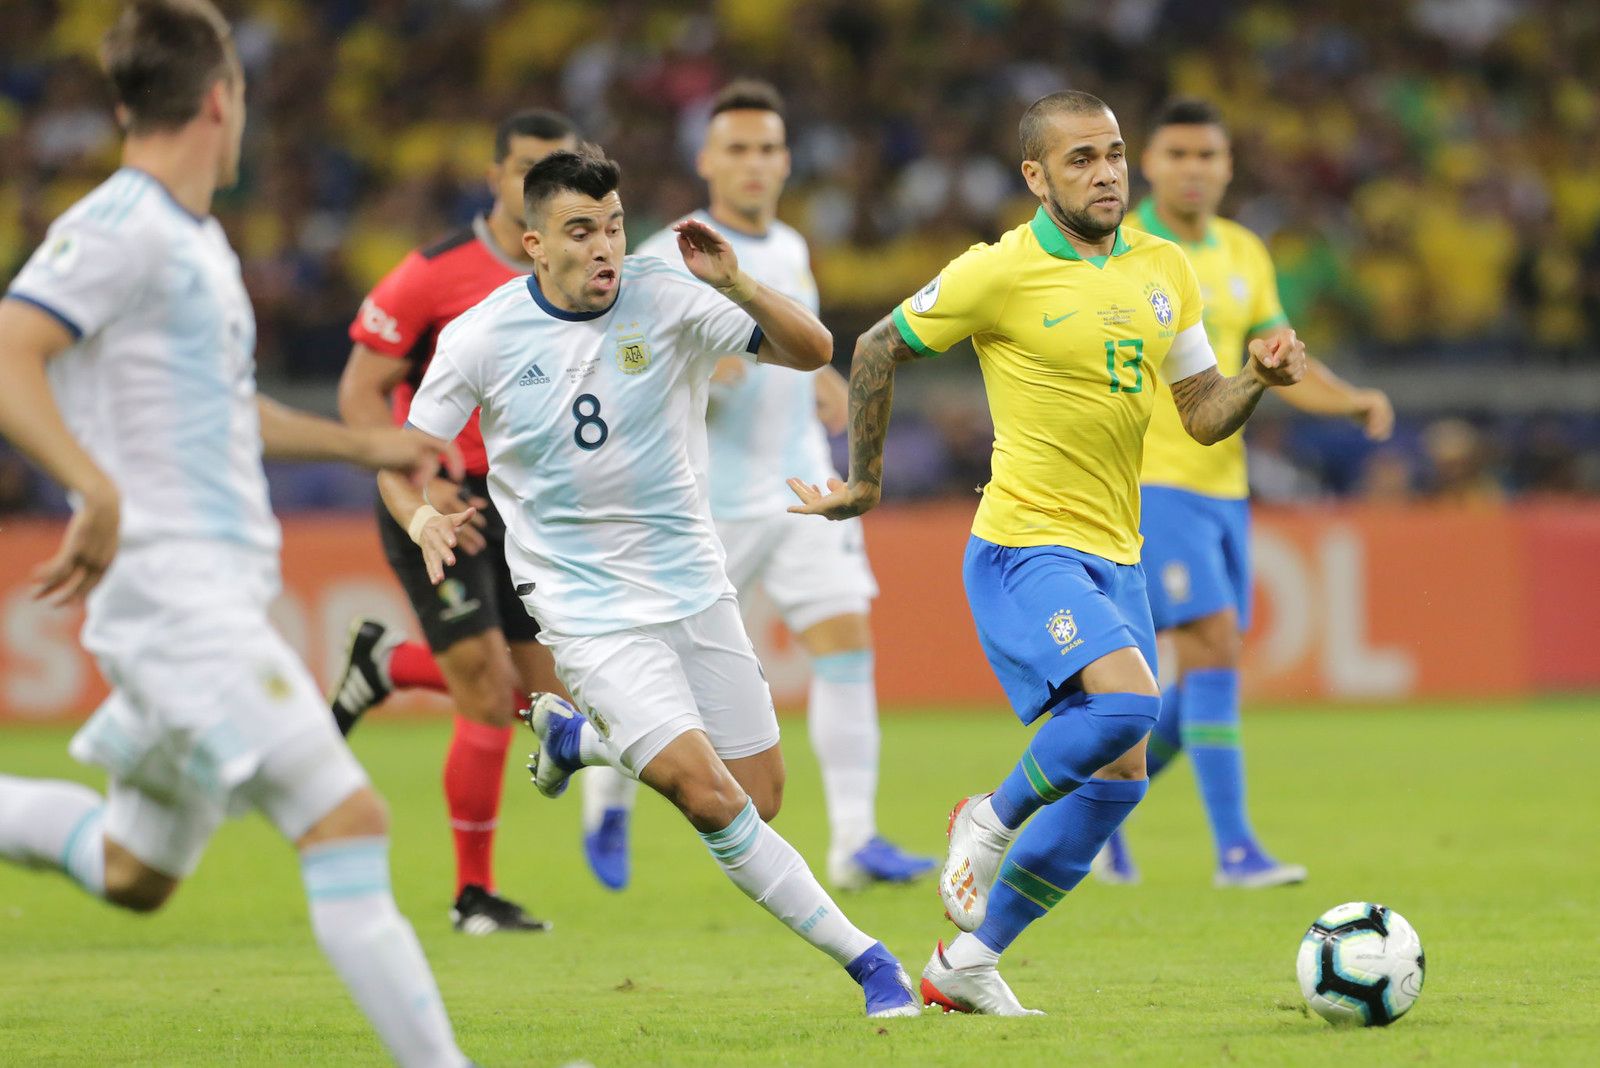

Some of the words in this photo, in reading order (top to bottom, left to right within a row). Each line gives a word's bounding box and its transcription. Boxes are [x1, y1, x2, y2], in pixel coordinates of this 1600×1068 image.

[625, 345, 643, 363] AFA
[1104, 338, 1143, 393] 13
[519, 376, 550, 386] adidas
[572, 393, 609, 451] 8
